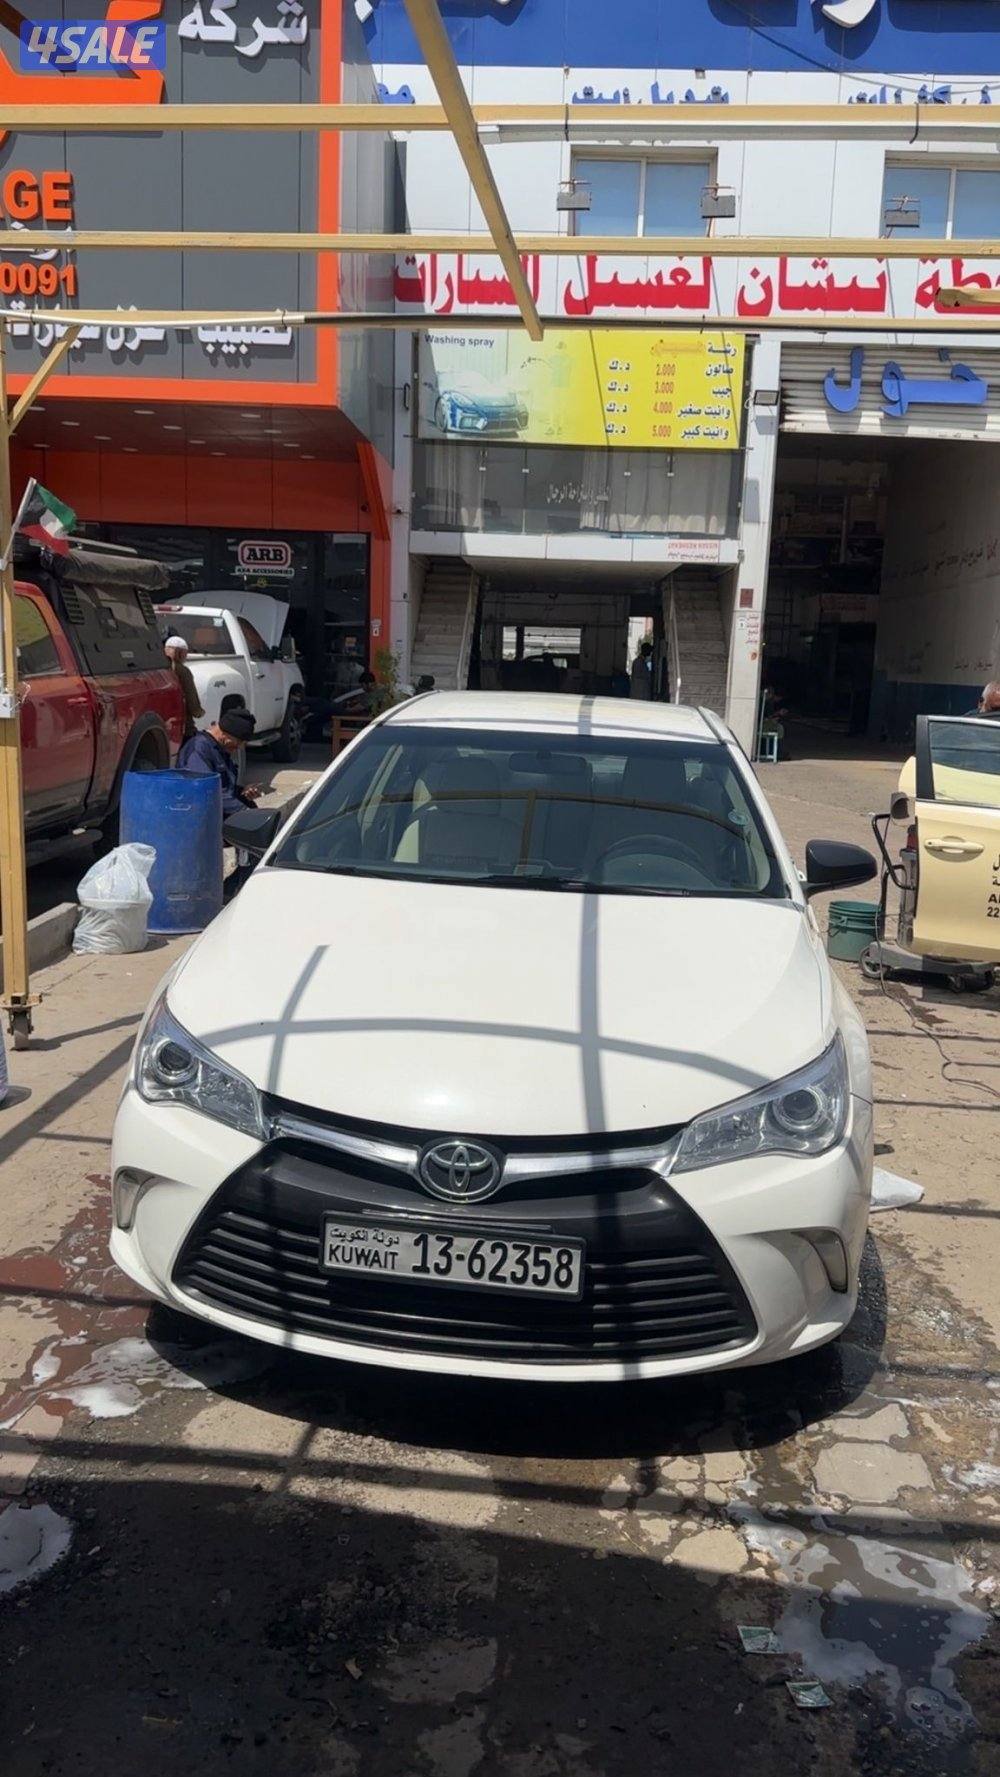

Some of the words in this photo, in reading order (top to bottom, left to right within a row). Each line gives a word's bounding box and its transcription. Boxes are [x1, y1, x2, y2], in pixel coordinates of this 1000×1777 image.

[0, 169, 73, 221] GE
[425, 334, 466, 346] Washing
[468, 337, 494, 347] spray
[656, 364, 676, 376] 2.000
[705, 363, 734, 377] صالون
[655, 381, 674, 394] 3.000
[712, 386, 732, 398] جيب
[653, 401, 673, 414] 4.000
[704, 404, 731, 420] وانيت
[652, 424, 671, 437] 5.000
[681, 424, 701, 439] كبير
[703, 425, 730, 440] وانيت
[246, 547, 284, 562] ARB
[331, 1228, 368, 1242] الكويت
[372, 1228, 400, 1247] دولة
[328, 1243, 399, 1270] KUWAIT
[411, 1233, 574, 1290] 13-62358
